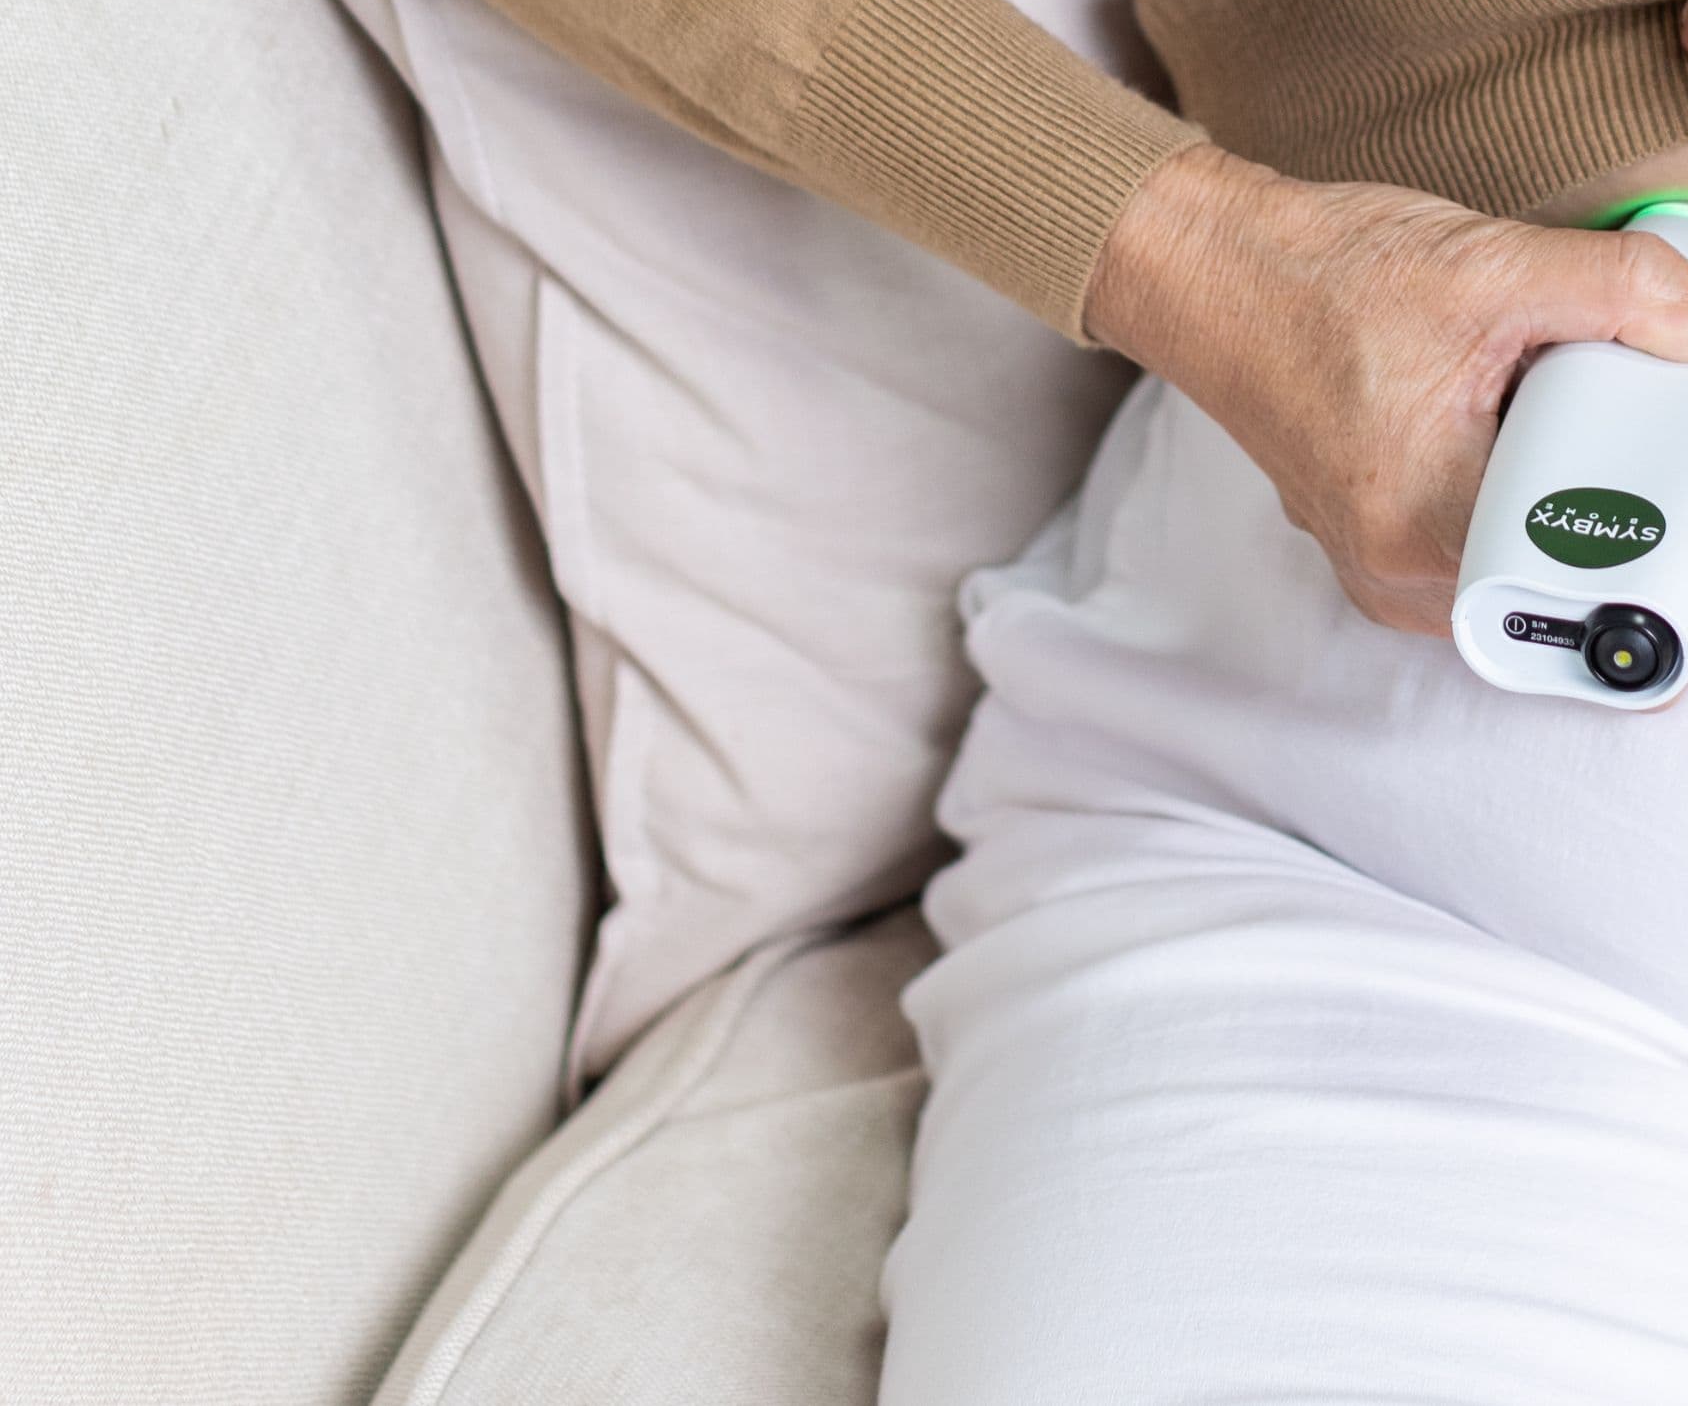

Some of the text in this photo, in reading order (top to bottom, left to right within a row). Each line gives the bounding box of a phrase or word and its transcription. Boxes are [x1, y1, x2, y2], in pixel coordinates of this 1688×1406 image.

[1530, 508, 1660, 541] SYMBYX
[1545, 502, 1639, 525] BIOME
[1531, 620, 1548, 630] S/N
